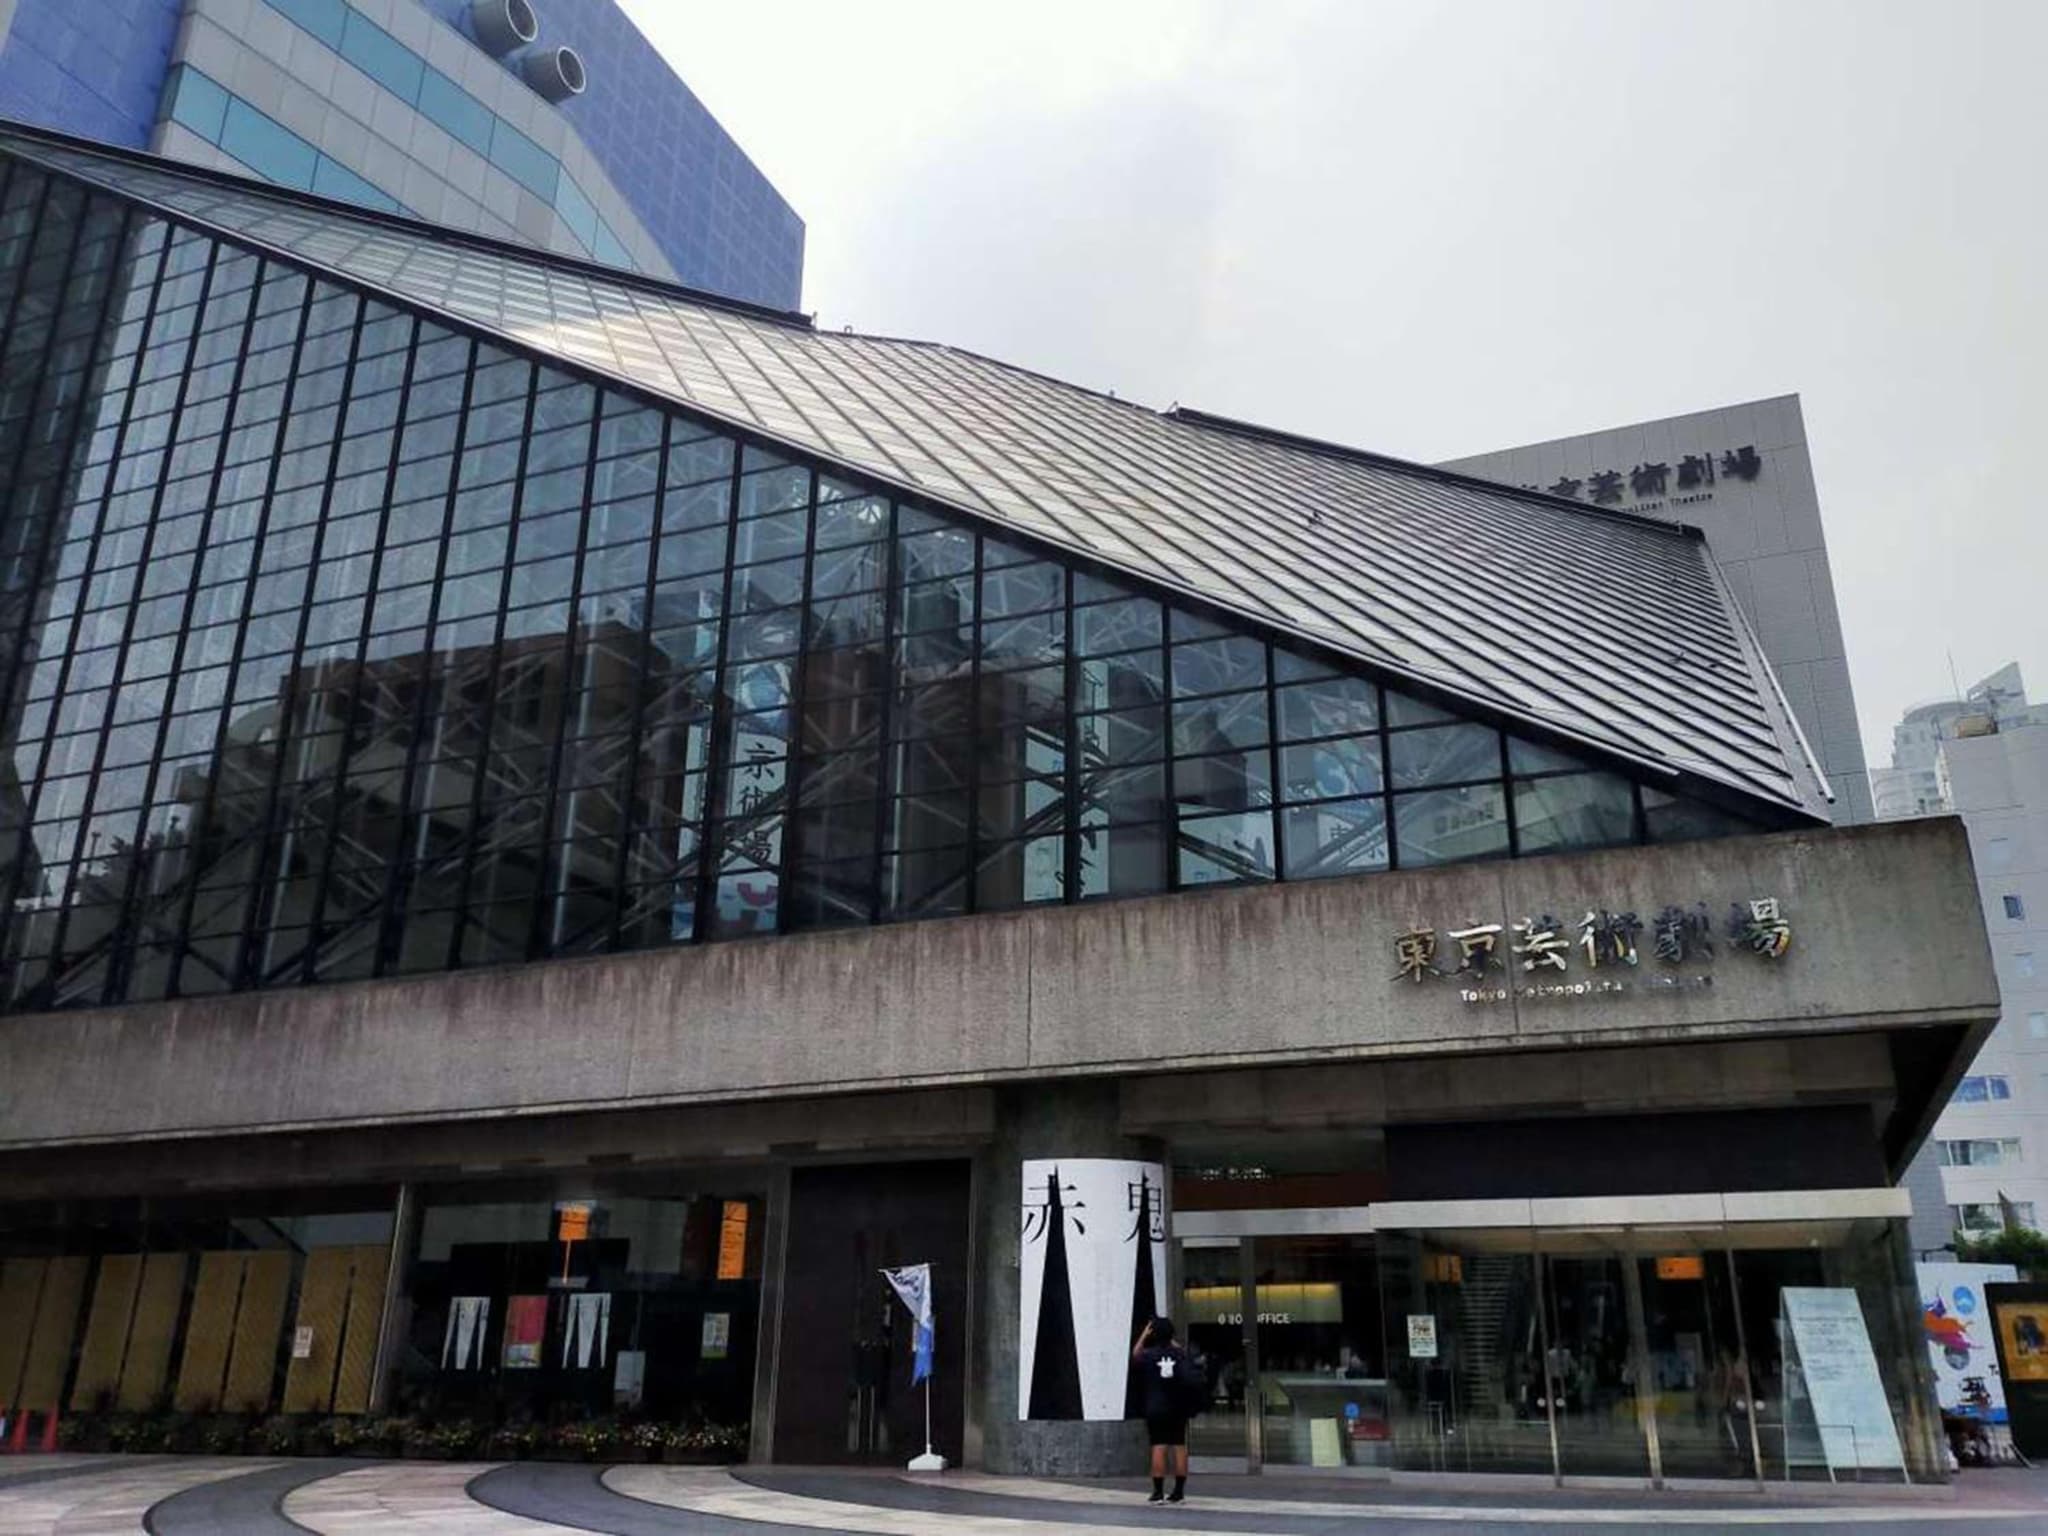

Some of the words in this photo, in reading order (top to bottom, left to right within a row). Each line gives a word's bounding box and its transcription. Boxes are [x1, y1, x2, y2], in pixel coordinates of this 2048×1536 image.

[1521, 446, 1761, 504] 京芸術劇場
[1391, 897, 1790, 984] 東京芸術劇場
[1460, 988, 1507, 1002] Tokyo
